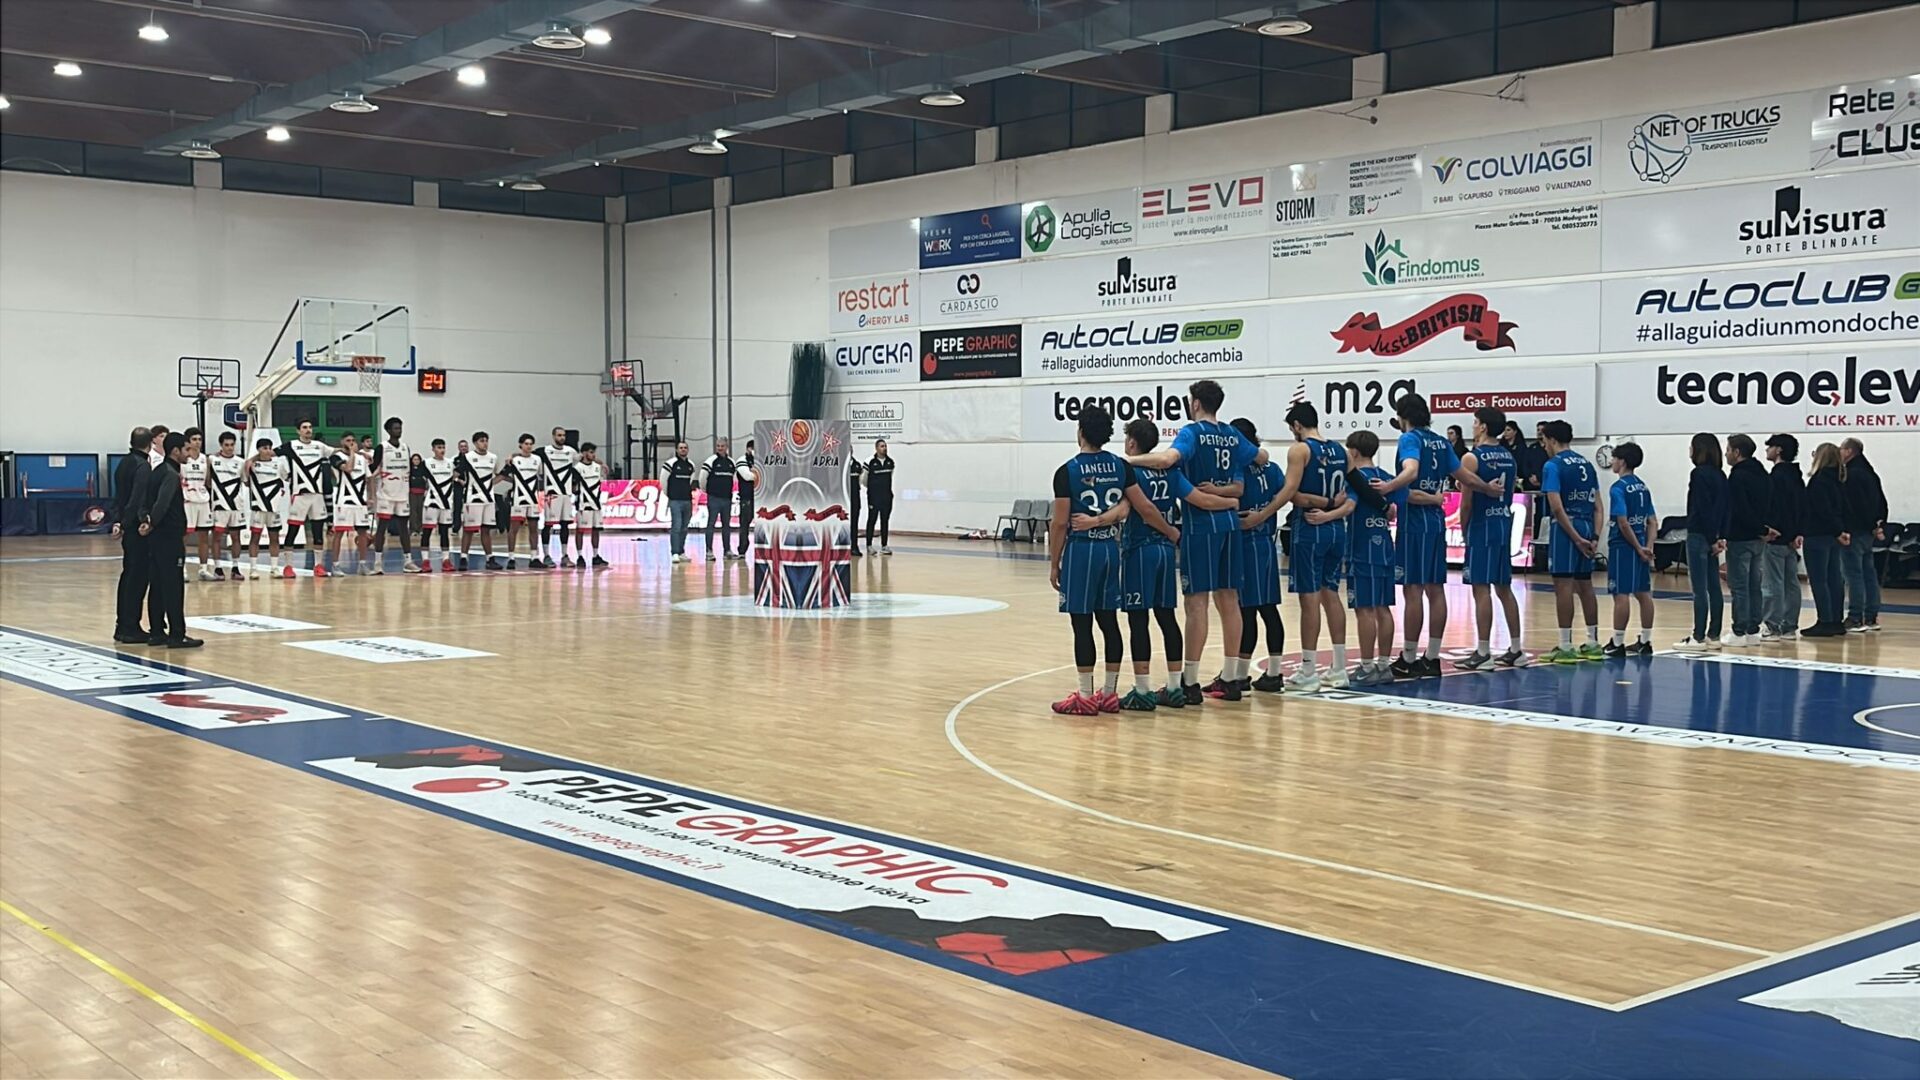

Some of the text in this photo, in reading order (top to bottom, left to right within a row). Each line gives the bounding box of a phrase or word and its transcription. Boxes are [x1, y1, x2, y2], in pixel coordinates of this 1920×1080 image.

[1829, 88, 1895, 117] Rete
[1650, 105, 1780, 138] NET OF TRUCKS
[1466, 145, 1592, 181] COLVIAGGI
[1142, 176, 1264, 218] ELEVO
[1463, 190, 1493, 202] CAPURSO
[1503, 185, 1541, 197] TRIGGIANO
[1551, 179, 1592, 191] VALENZANO
[1061, 208, 1111, 227] Apulia
[1276, 197, 1315, 222] STORM
[1061, 221, 1133, 241] Logistics
[1745, 235, 1878, 255] PORTE BLINDATE
[1398, 257, 1481, 278] Findomus
[838, 278, 909, 312] restart
[939, 297, 1000, 313] CARDASCIO
[1102, 299, 1127, 307] PORTE
[894, 313, 910, 324] LAB
[1184, 323, 1240, 338] GROUP
[934, 333, 1018, 354] PEPE GRAPHIC
[836, 342, 913, 366] EUREKA
[1042, 346, 1243, 373] #allaguidadiunmondochecambia
[422, 373, 444, 390] 24
[1491, 394, 1562, 408] Fotovoltaico
[1324, 420, 1384, 430] GROUP
[1806, 414, 1852, 427] CLICK.
[1857, 414, 1901, 426] RENT.
[763, 455, 840, 467] ADRIA ADRIA
[1080, 461, 1117, 475] IANELLI
[1214, 448, 1231, 470] 18
[1579, 465, 1588, 481] 3
[1150, 480, 1169, 501] 22
[1126, 592, 1142, 606] 22
[520, 775, 1010, 895] PEPE GRAPHIC
[863, 884, 932, 905] visiva
